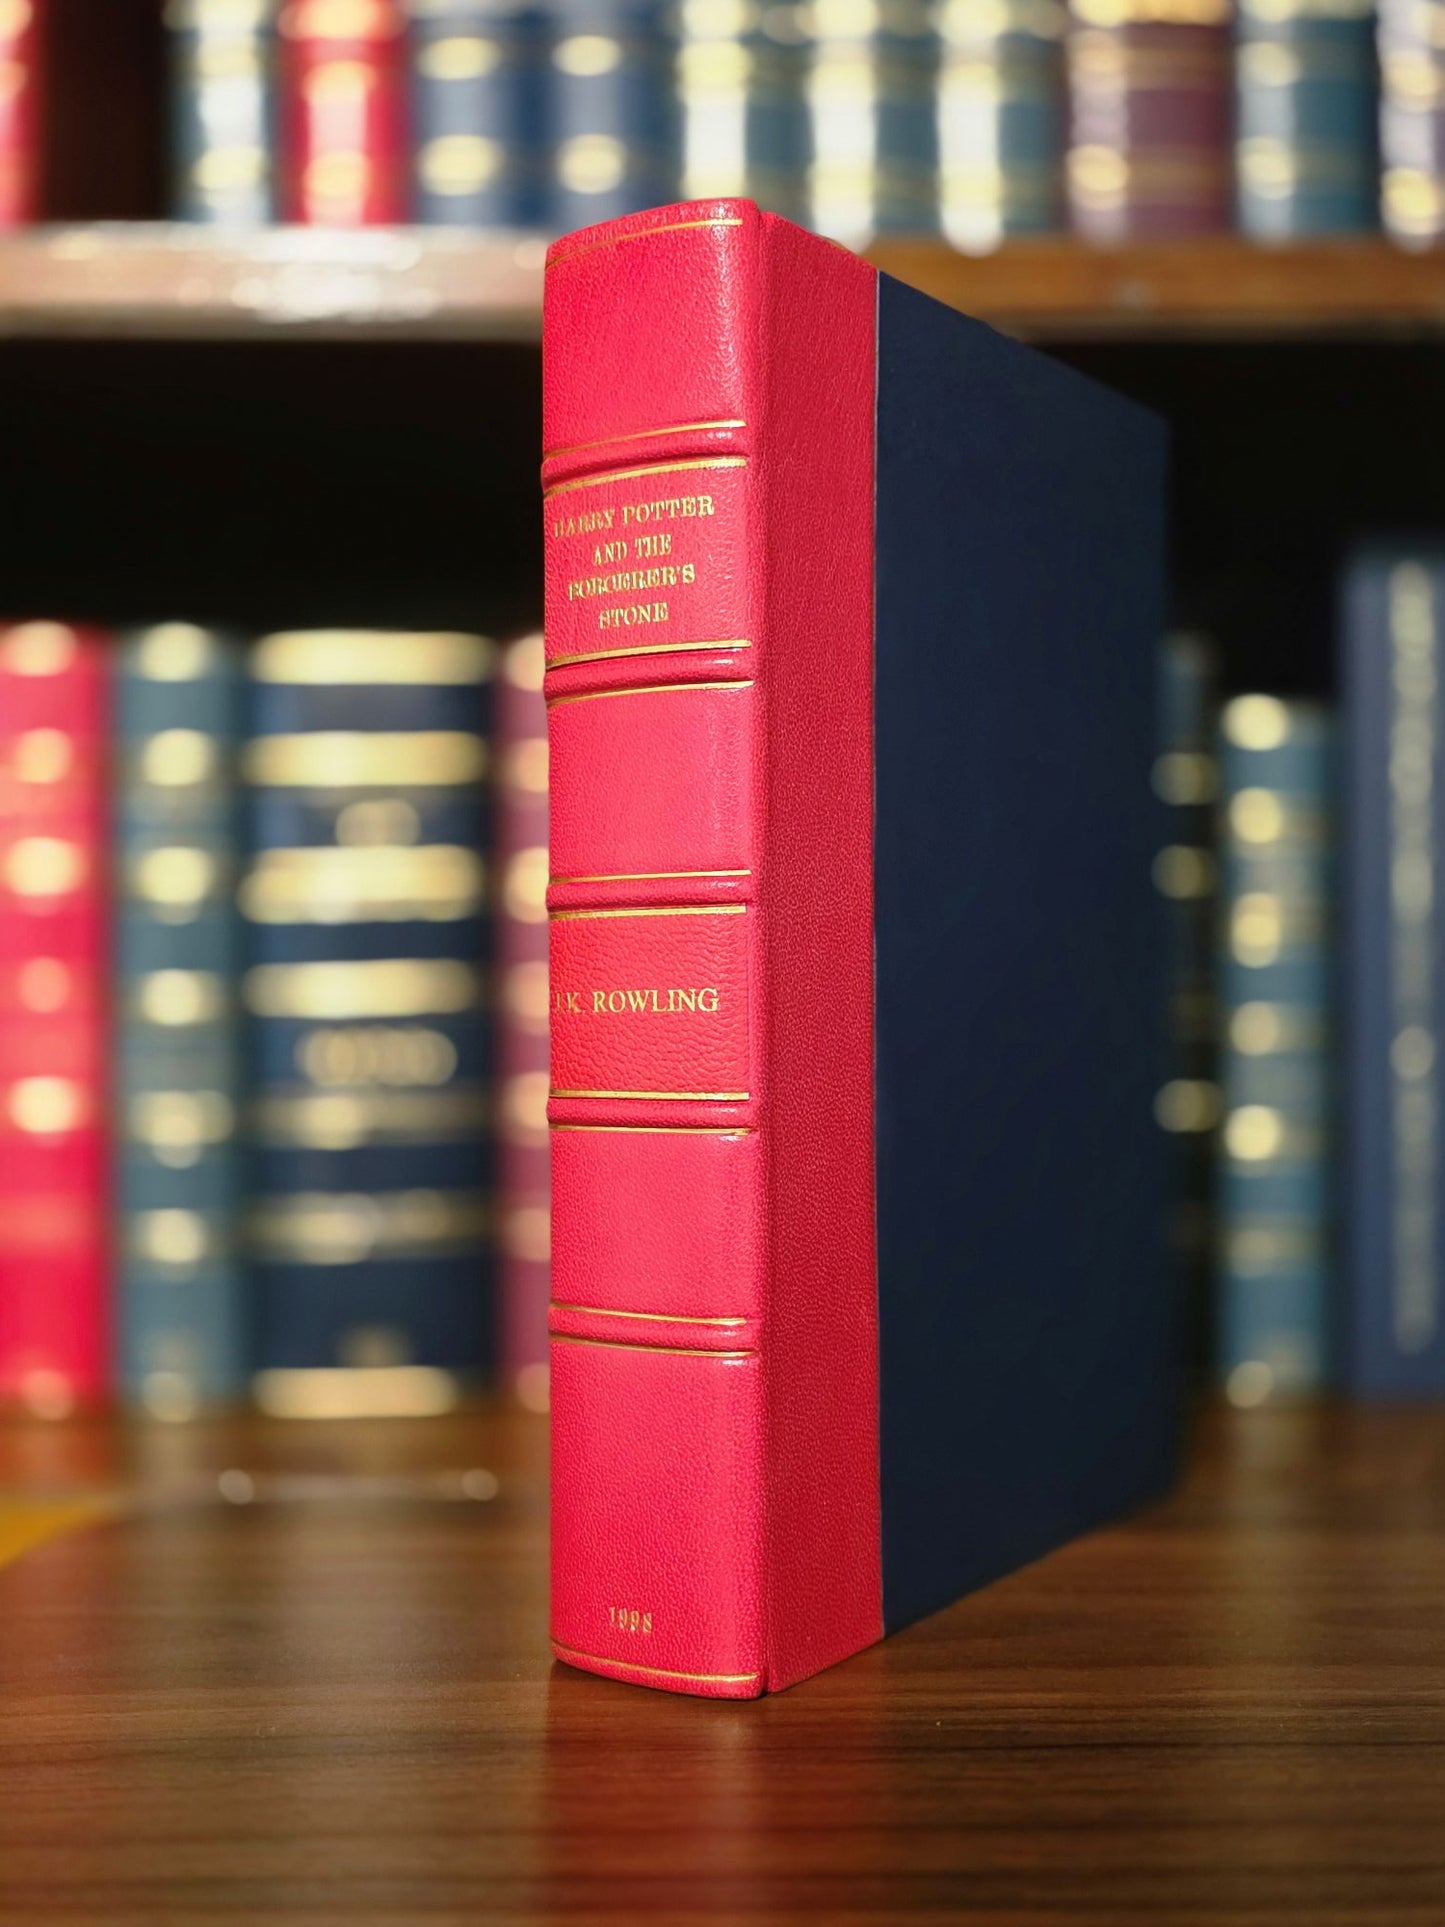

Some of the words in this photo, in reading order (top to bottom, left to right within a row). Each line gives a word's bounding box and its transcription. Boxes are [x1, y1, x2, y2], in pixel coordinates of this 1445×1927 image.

[622, 495, 716, 525] POTTER
[593, 541, 628, 566] AND
[634, 533, 673, 559] THE
[598, 601, 669, 630] STONE
[592, 987, 721, 1014] ROWLING
[609, 1606, 653, 1634] 1998
